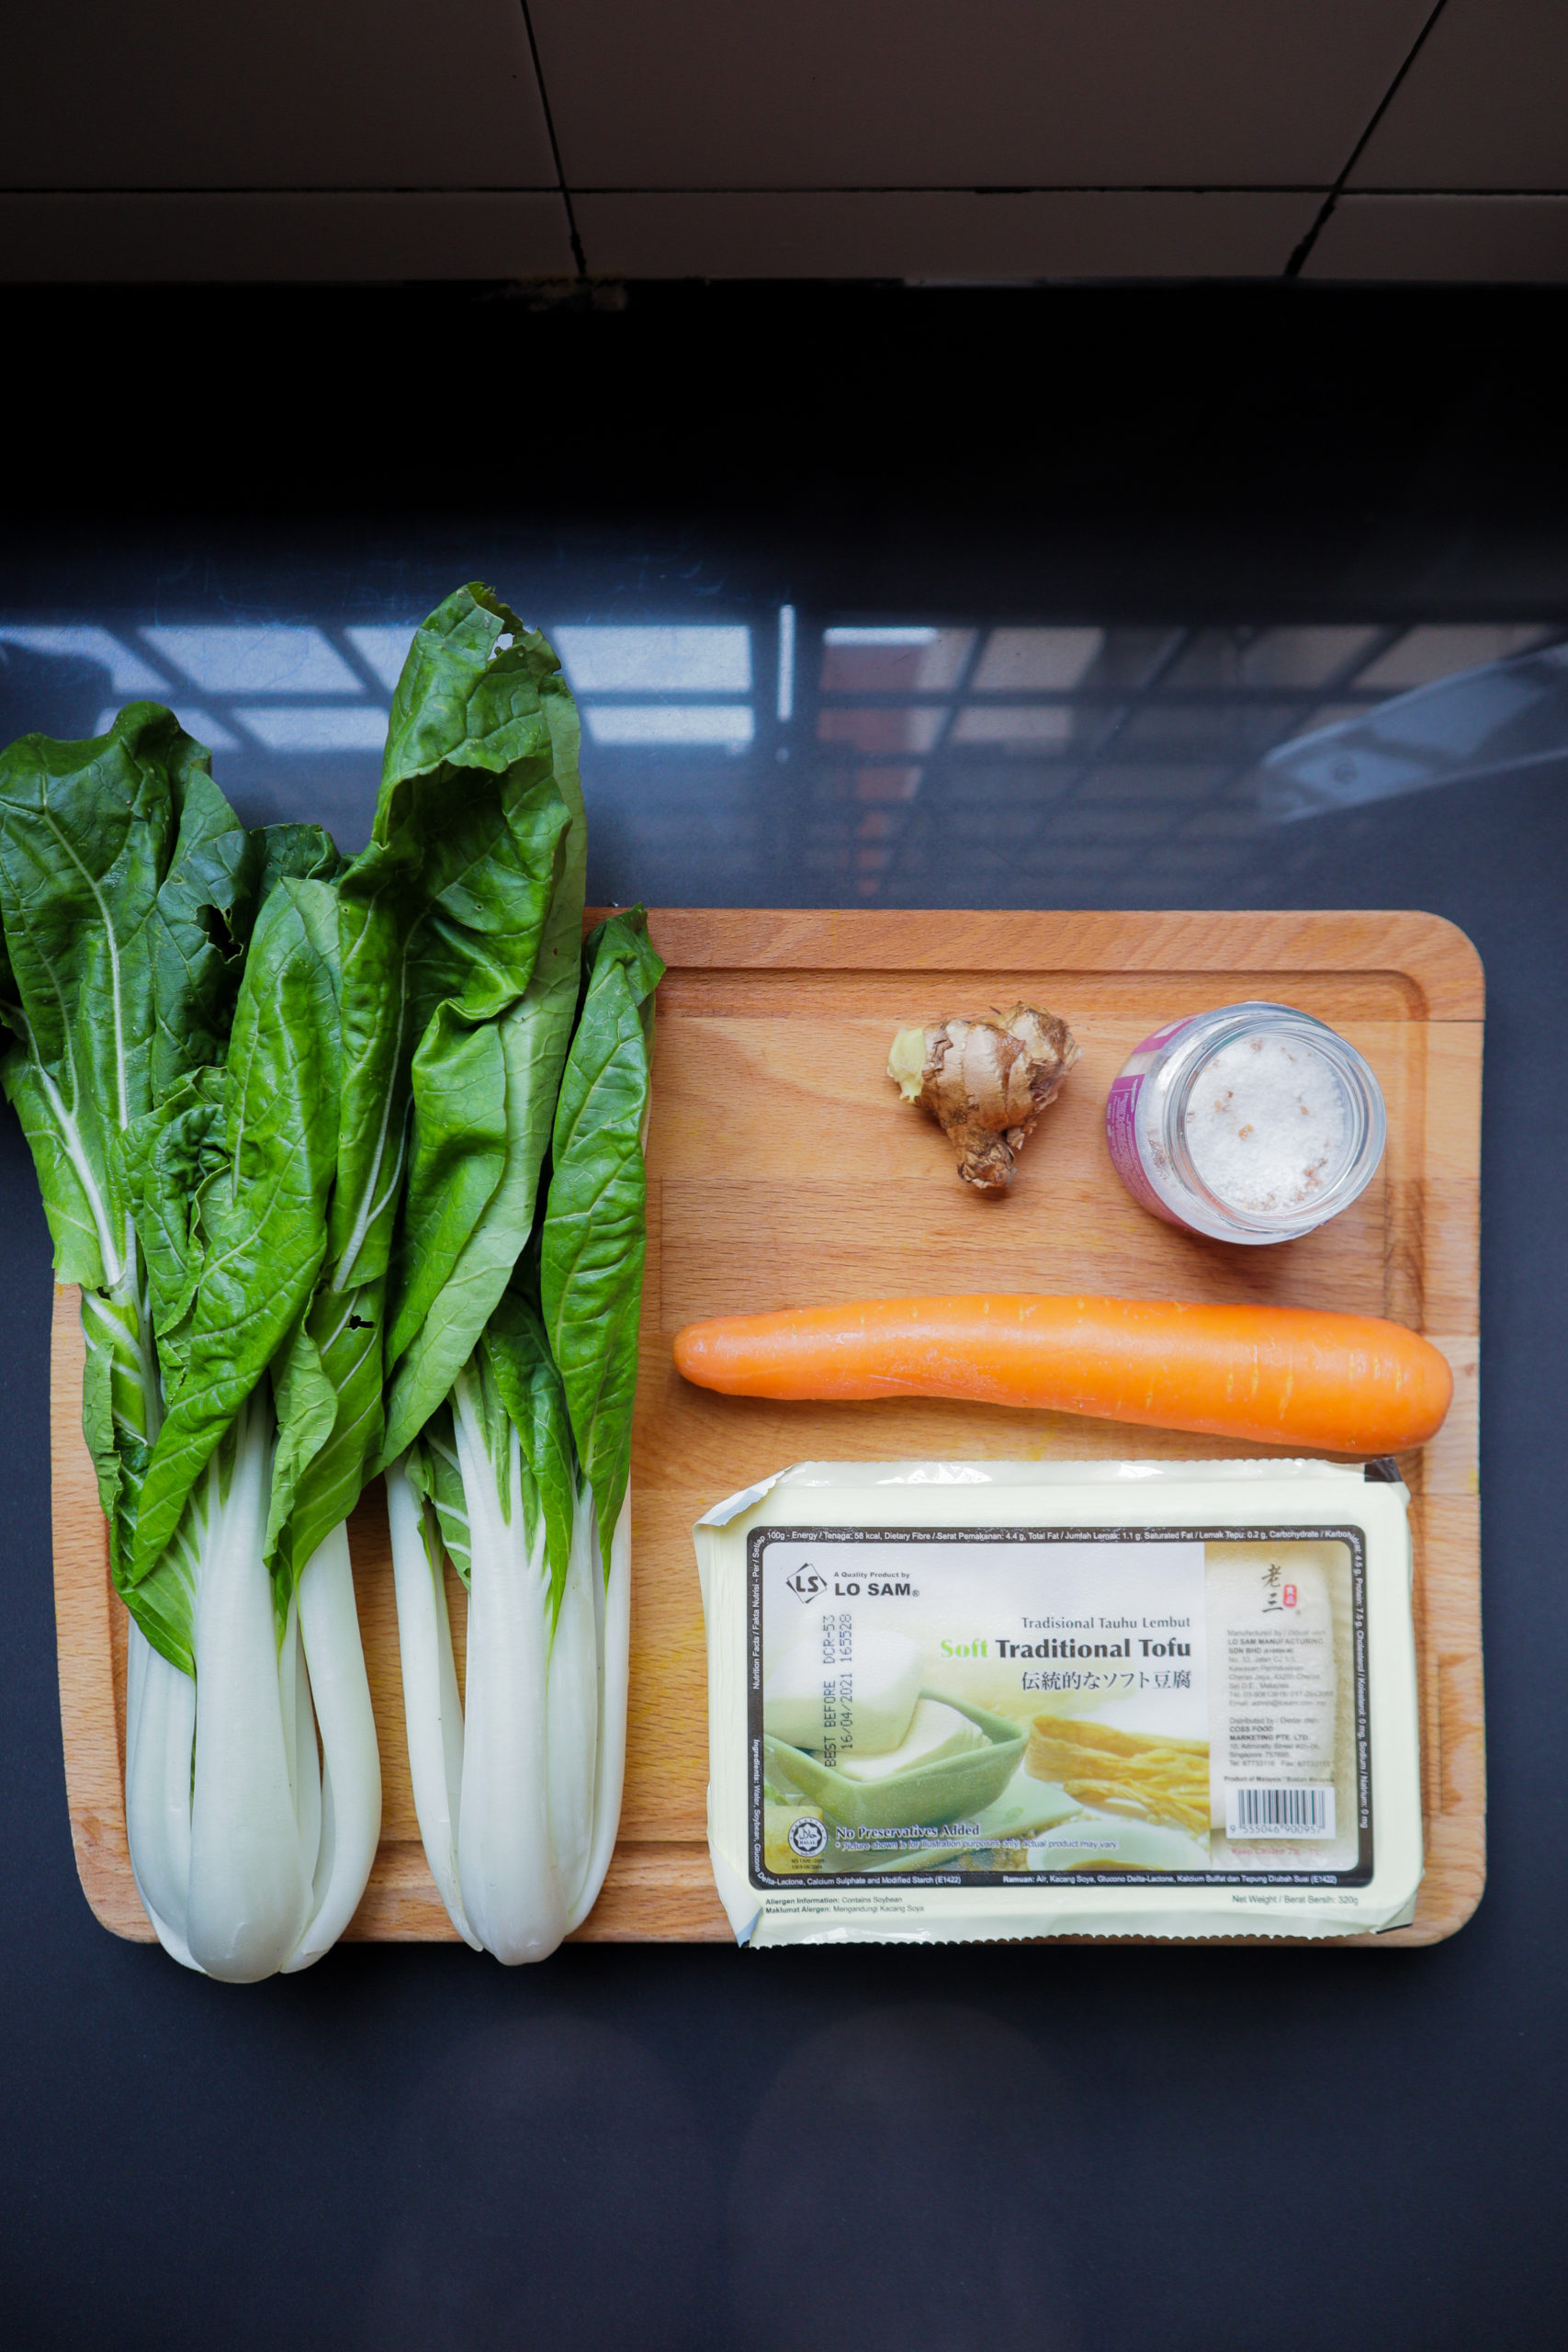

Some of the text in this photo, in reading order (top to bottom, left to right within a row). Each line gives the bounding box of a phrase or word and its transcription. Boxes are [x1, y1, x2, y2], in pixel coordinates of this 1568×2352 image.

[767, 1532, 785, 1541] 100g
[792, 1532, 817, 1541] Energy
[824, 1532, 852, 1541] Tenaga:
[854, 1532, 863, 1540] 58
[866, 1532, 883, 1541] kcal,
[885, 1532, 910, 1542] Dietary
[912, 1532, 931, 1540] Fibre
[937, 1532, 956, 1540] Serat
[959, 1532, 1004, 1541] Pemakanan:
[1029, 1532, 1045, 1540] Total
[1047, 1532, 1059, 1540] Fat
[1065, 1532, 1091, 1540] Jumlah
[1145, 1532, 1179, 1540] Saturated
[1181, 1531, 1193, 1540] Fat
[1200, 1531, 1224, 1539] Lemak
[1247, 1531, 1259, 1539] 0.2
[1269, 1531, 1319, 1540] Carbohydrate
[751, 1566, 760, 1578] Per
[835, 1583, 861, 1597] LO
[1355, 1577, 1364, 1606] Protein:
[751, 1585, 760, 1608] Nutrisi
[1021, 1616, 1190, 1629] Tradisional Tauhu Lembut
[941, 1637, 1190, 1658] Soft Traditional Tofu
[1356, 1630, 1366, 1671] Cholesterol
[840, 1613, 852, 1749] 16/04/2021 165528
[1021, 1670, 1191, 1690] 伝統的なソフト豆腐
[823, 1614, 836, 1767] BEST BEFORE DCR-53
[1359, 1741, 1368, 1770] Sodium
[751, 1739, 760, 1783] Ingredients:
[807, 1877, 835, 1885] Calcium
[836, 1877, 865, 1886] Sulphate
[882, 1876, 910, 1884] Modified
[912, 1876, 933, 1884] Starch
[935, 1875, 962, 1884] (E1422)
[1359, 1816, 1369, 1828] mg
[836, 1826, 855, 1839] No
[858, 1824, 939, 1839] Preservatives
[940, 1823, 981, 1837] Added
[1229, 1825, 1322, 1834] 9 555046 900957
[842, 1840, 870, 1851] Picture
[872, 1839, 898, 1849] shown
[899, 1839, 907, 1849] is
[908, 1839, 919, 1849] for
[964, 1839, 1000, 1849] purposes
[1022, 1839, 1045, 1848] actual
[1048, 1839, 1078, 1849] product
[1080, 1840, 1098, 1849] may
[1003, 1875, 1035, 1883] Ramuan:
[1036, 1875, 1049, 1884] Air,
[1050, 1875, 1076, 1884] Kacang
[1077, 1875, 1097, 1884] Soya,
[1097, 1874, 1125, 1883] Glucono
[1127, 1874, 1176, 1883] Delta-Lactone,
[1227, 1874, 1240, 1883] dan
[1242, 1874, 1267, 1884] Tepung
[1269, 1874, 1292, 1883] Diubah
[1311, 1874, 1337, 1884] (E1422)
[765, 1898, 795, 1906] Allergen
[874, 1896, 903, 1905] Soybean
[1232, 1894, 1247, 1904] Net
[1249, 1894, 1278, 1905] Weight
[1284, 1894, 1305, 1904] Berat
[1337, 1895, 1359, 1906] 320g
[801, 1905, 831, 1915] Alergen:
[833, 1905, 877, 1914] Mengandungi
[879, 1905, 905, 1914] Kacang
[907, 1905, 924, 1913] Soya
